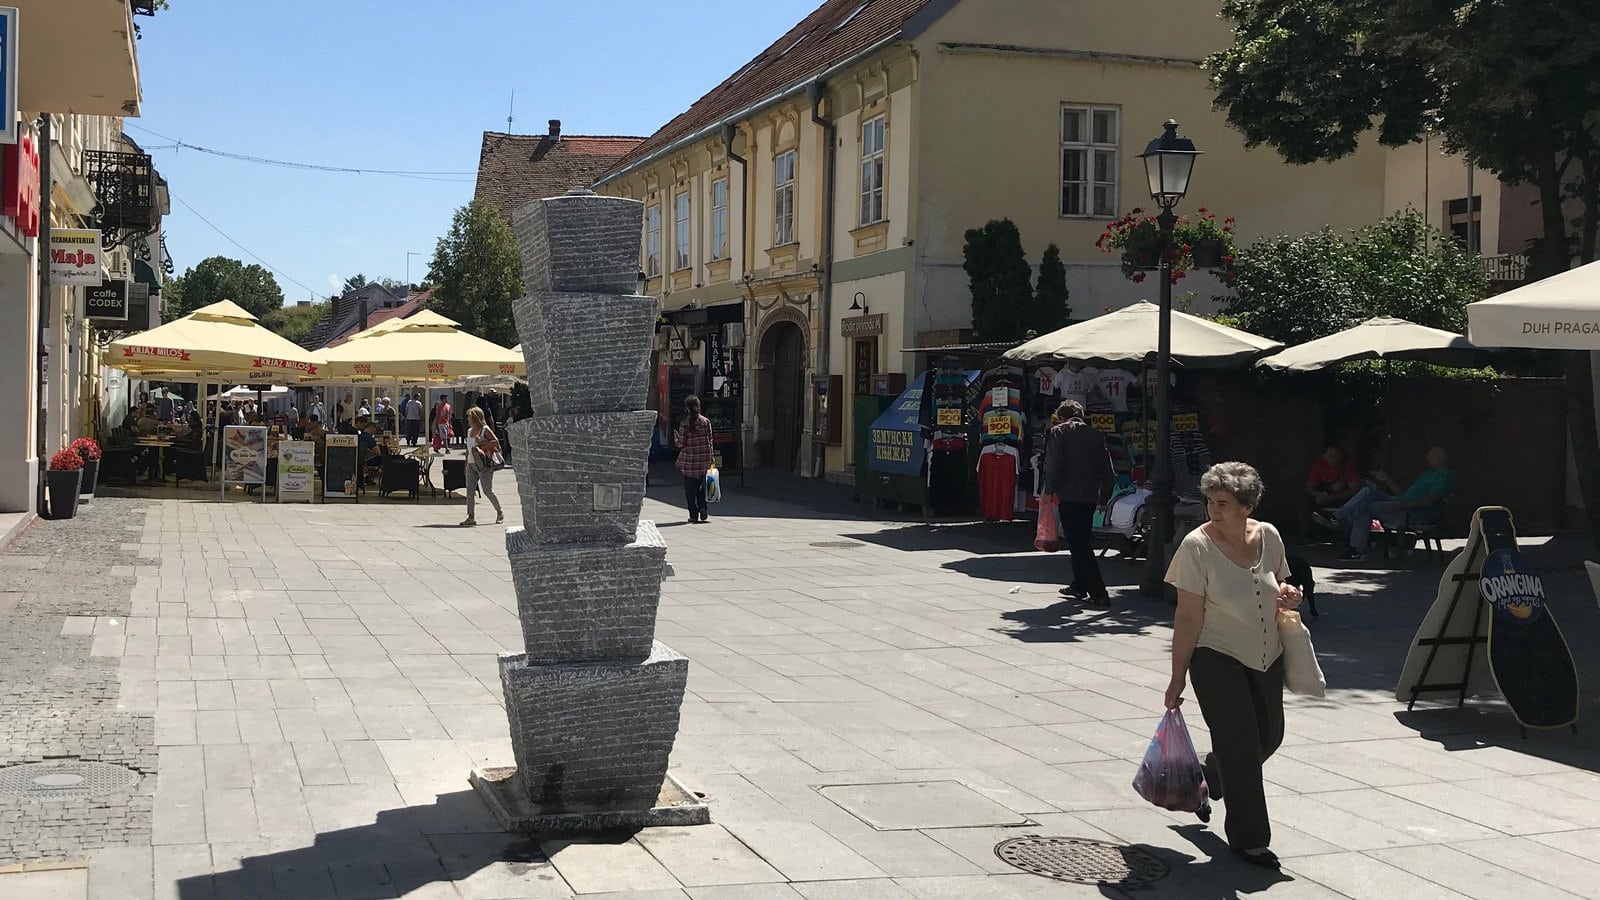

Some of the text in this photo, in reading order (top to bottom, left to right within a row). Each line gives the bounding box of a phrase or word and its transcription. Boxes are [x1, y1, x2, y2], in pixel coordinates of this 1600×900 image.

[51, 236, 95, 244] OZAMANTERIJA
[50, 248, 96, 268] Maja
[93, 289, 117, 298] caffe
[88, 298, 122, 308] CODEX
[1522, 321, 1600, 334] DUH PRAGA
[1106, 381, 1120, 397] 11
[1481, 574, 1545, 602] ORANGINA
